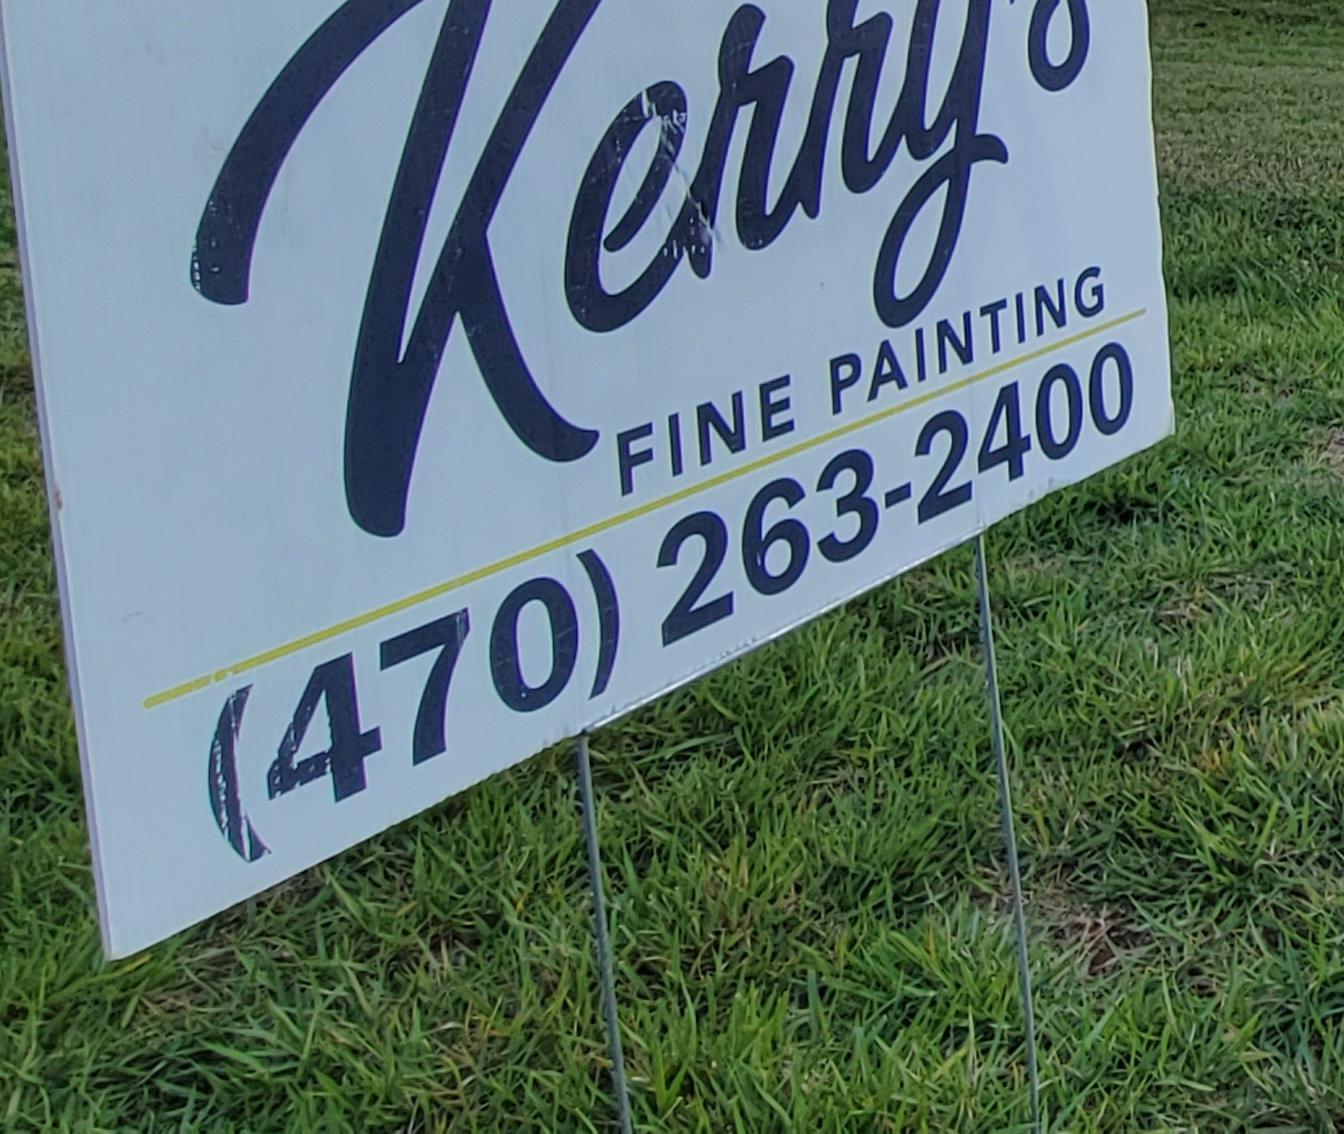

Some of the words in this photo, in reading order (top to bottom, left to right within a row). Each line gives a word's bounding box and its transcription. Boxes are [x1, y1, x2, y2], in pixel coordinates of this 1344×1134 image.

[617, 372, 794, 497] FINE
[829, 265, 1106, 417] PAINTING
[207, 548, 621, 863] (470)
[659, 340, 1133, 648] 263-2400
